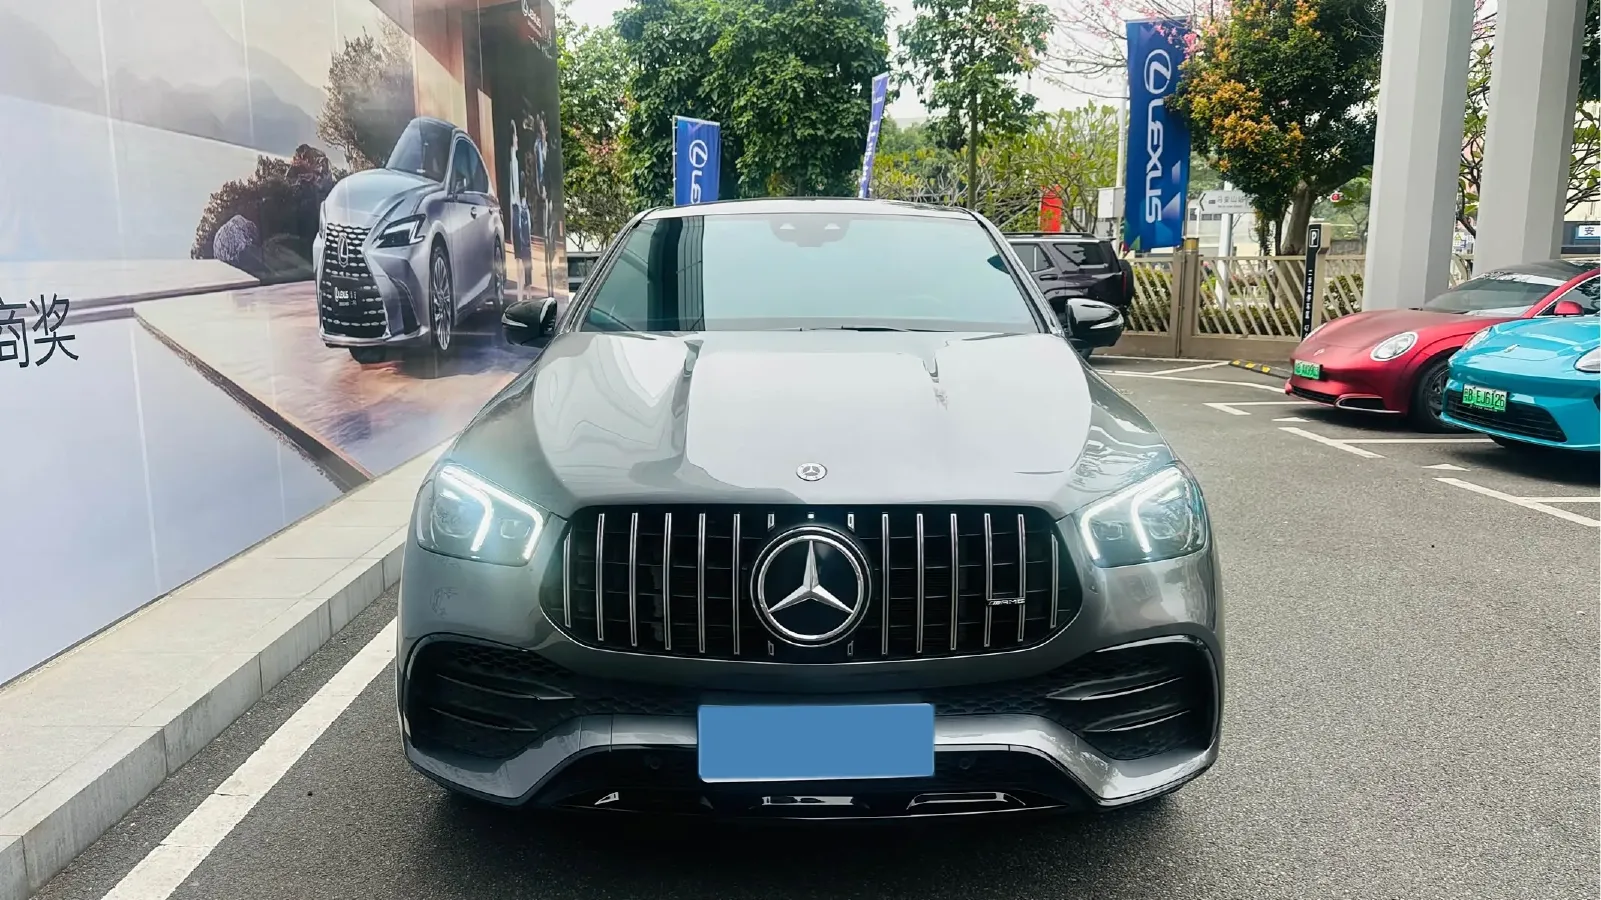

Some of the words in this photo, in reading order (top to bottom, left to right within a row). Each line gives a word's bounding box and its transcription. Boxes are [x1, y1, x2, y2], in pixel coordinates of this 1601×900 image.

[690, 169, 703, 205] LE
[1145, 99, 1164, 224] LEXUS
[0, 293, 79, 368] 商奖
